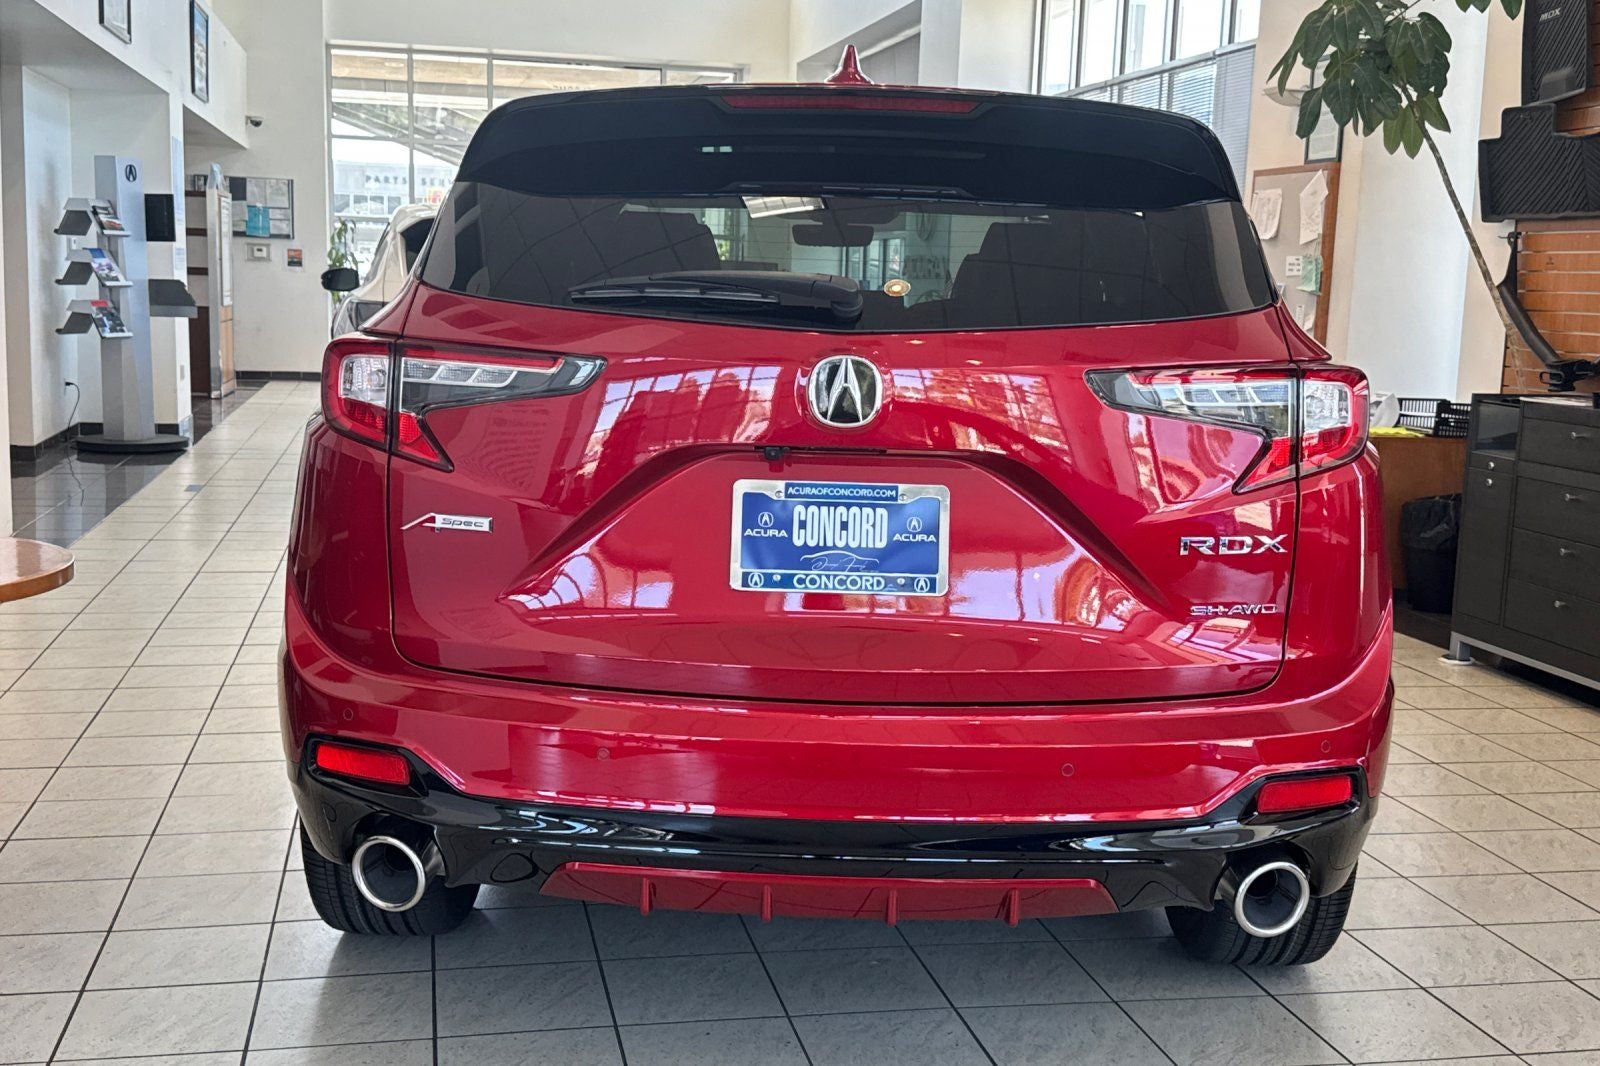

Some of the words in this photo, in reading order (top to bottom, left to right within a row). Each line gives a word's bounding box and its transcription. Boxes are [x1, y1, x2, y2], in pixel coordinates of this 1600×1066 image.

[365, 174, 408, 186] PARTS
[787, 486, 896, 498] ACURAOFCONCORD.COM
[792, 504, 888, 549] CONCORD
[743, 528, 788, 538] ACURA
[892, 533, 937, 543] ACURA
[1179, 533, 1288, 555] RDX
[793, 573, 886, 591] CONCORD
[1190, 603, 1278, 616] SH-AWD
